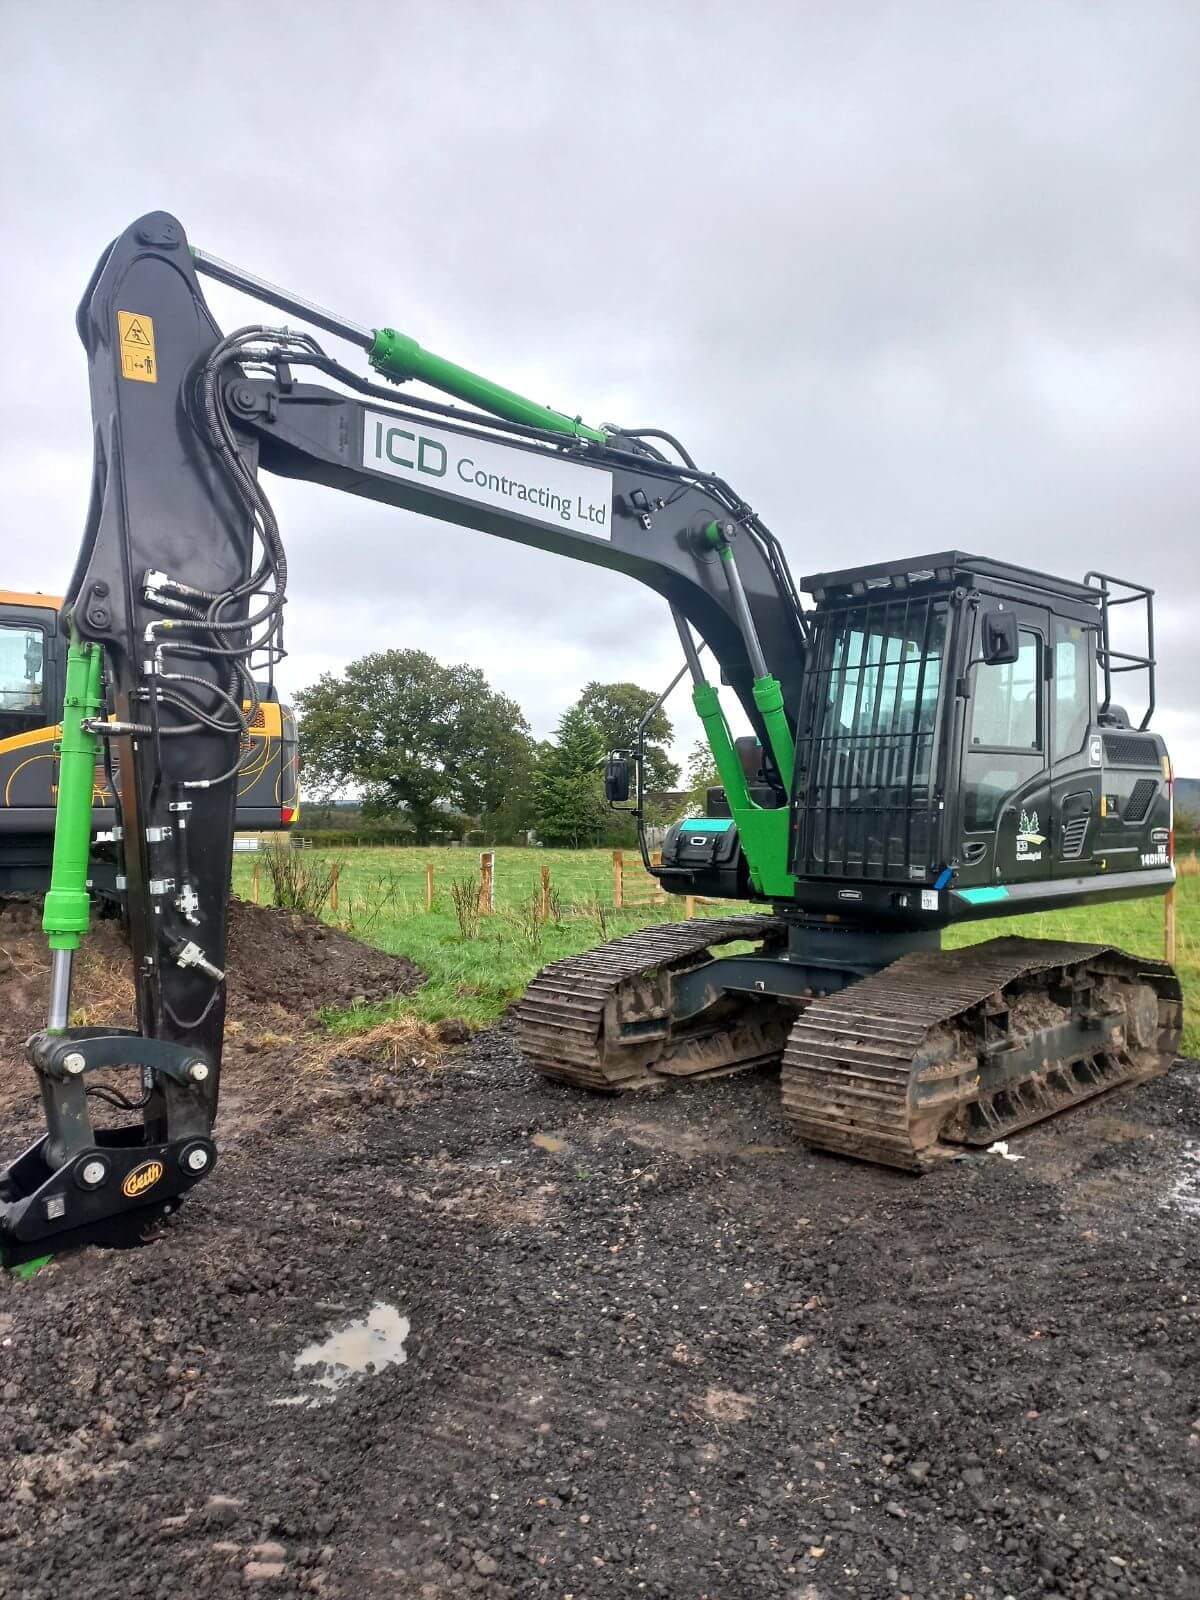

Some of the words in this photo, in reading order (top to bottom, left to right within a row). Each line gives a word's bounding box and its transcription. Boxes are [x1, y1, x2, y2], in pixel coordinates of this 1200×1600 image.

[375, 421, 448, 478] ICD
[456, 458, 572, 521] Contracting
[577, 496, 606, 525] Ltd
[127, 1164, 159, 1194] Geith
